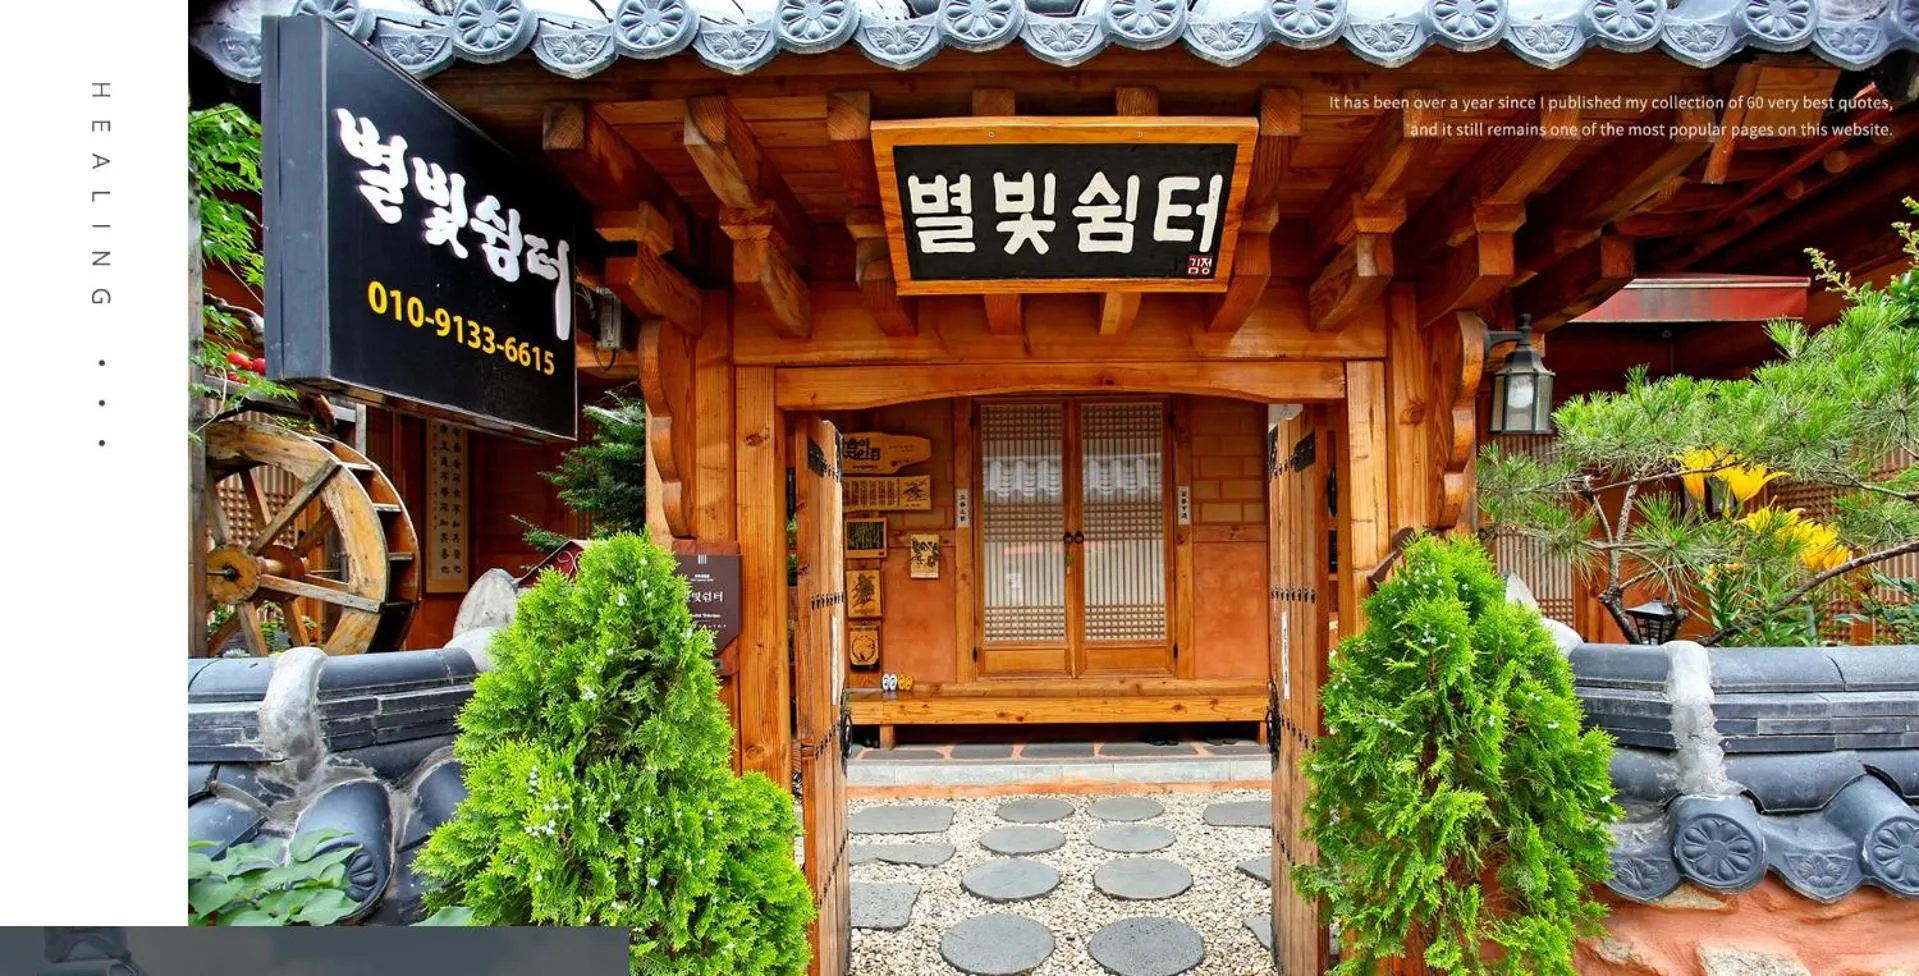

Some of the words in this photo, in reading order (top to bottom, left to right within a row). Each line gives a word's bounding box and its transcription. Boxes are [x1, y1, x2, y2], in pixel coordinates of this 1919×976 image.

[336, 106, 571, 342] 별빛쉼터
[907, 171, 1223, 255] 별빛쉼터
[367, 280, 556, 377] 010-9133-6615
